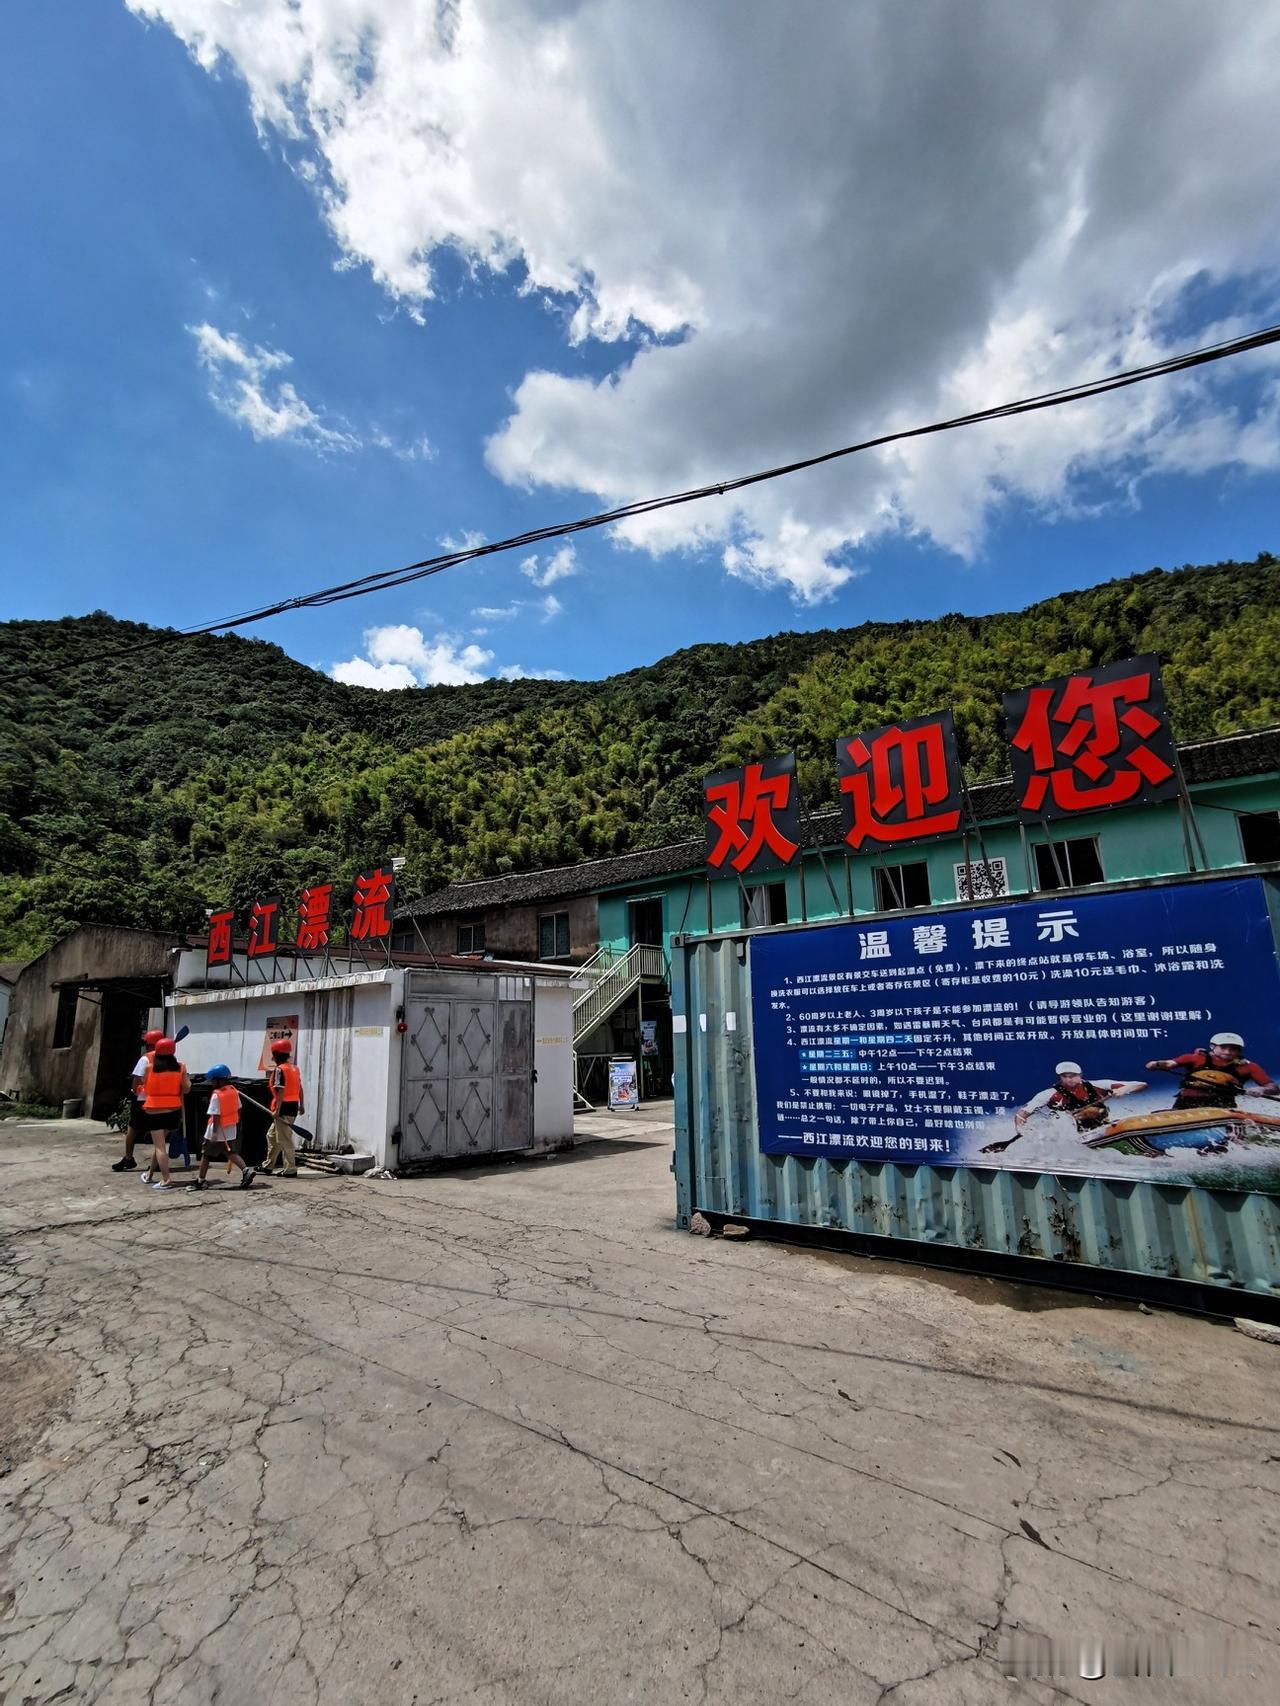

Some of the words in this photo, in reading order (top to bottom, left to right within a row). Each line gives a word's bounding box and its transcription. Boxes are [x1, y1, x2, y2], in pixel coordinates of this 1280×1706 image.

[706, 672, 1175, 873] 欢迎您
[208, 868, 394, 965] 西江漂流
[858, 911, 1080, 960] 温馨提示
